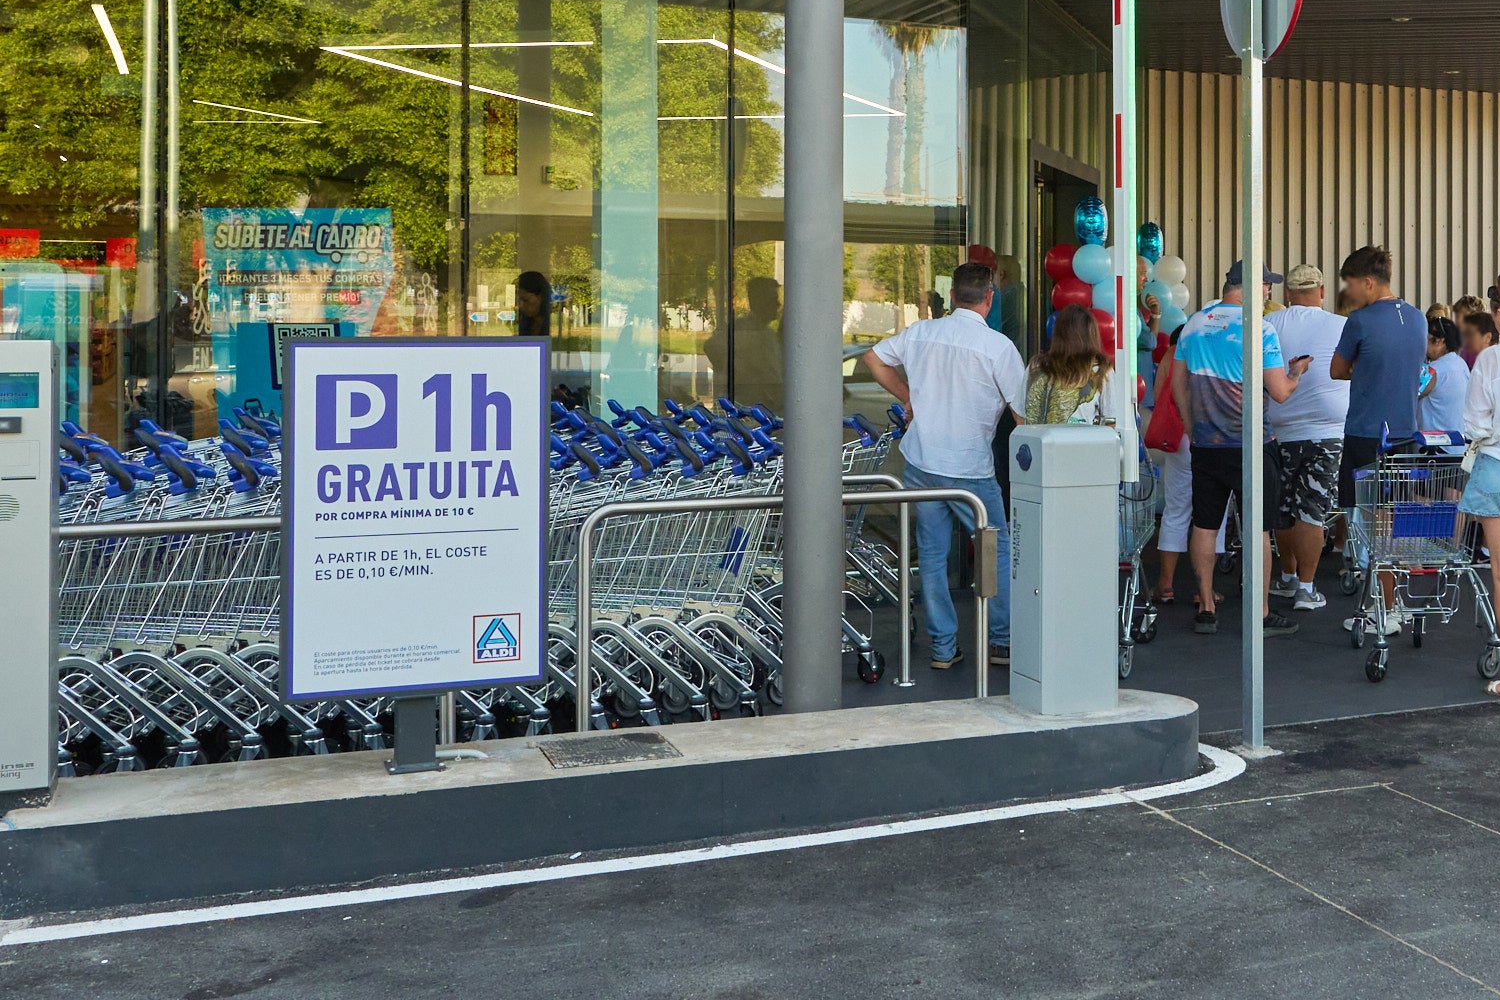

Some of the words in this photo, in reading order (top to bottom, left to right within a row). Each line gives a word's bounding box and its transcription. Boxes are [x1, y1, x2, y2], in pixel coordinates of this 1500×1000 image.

[214, 219, 288, 249] SÚBETE
[288, 224, 314, 249] AL
[315, 224, 383, 254] CARRO
[270, 274, 276, 283] 3
[278, 274, 311, 283] MESES
[314, 274, 333, 283] TUS
[335, 380, 387, 444] P
[422, 373, 512, 453] 1h
[316, 459, 520, 504] GRATUITA
[315, 512, 338, 522] POR
[341, 510, 388, 521] COMPRA
[390, 507, 432, 519] MÍNIMA
[435, 508, 449, 517] DE
[452, 507, 464, 516] 10
[467, 507, 475, 516] €
[314, 554, 324, 565] A
[328, 551, 377, 564] PARTIR
[381, 550, 399, 561] DE
[403, 549, 421, 562] 1h,
[425, 548, 442, 559] EL
[445, 546, 487, 558] COSTE
[315, 569, 332, 581] ES
[336, 568, 354, 580] DE
[358, 566, 385, 580] 0,10
[389, 565, 434, 577] €/MIN.
[314, 656, 352, 664] Aparcamiento
[354, 653, 382, 661] disponible
[480, 647, 514, 659] ALDI
